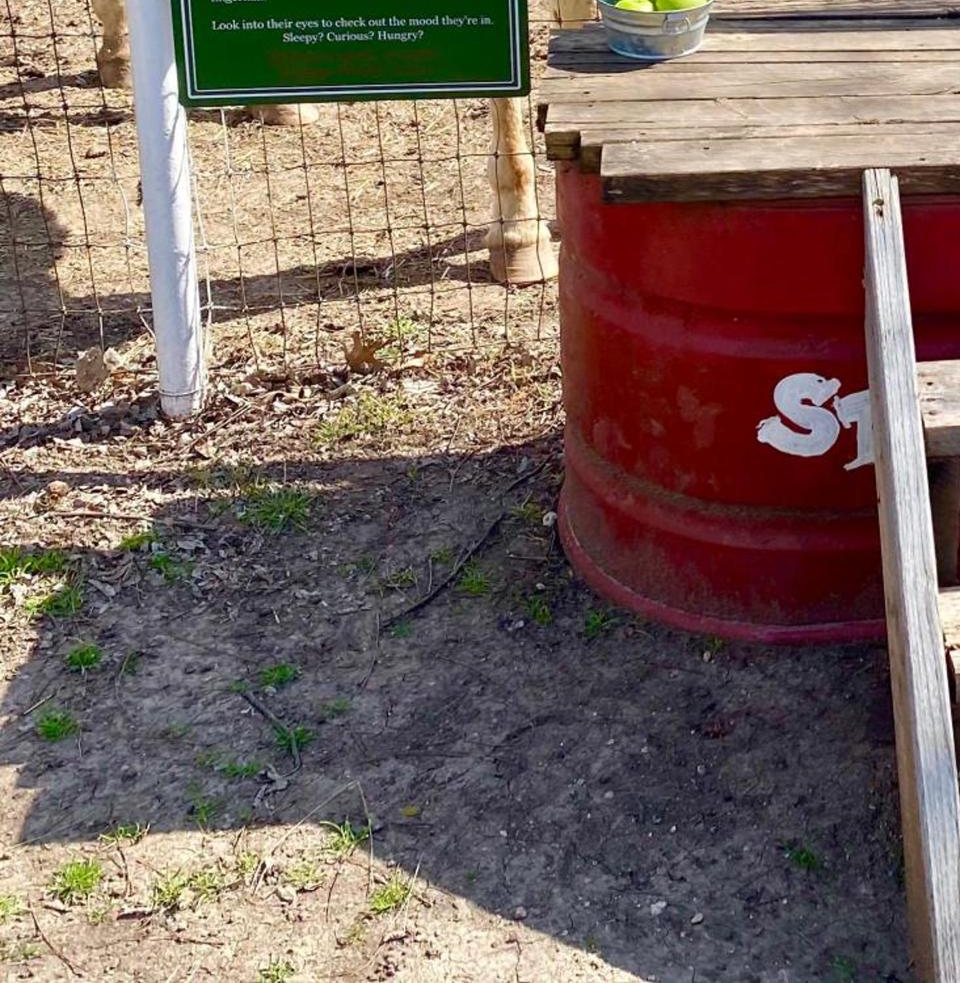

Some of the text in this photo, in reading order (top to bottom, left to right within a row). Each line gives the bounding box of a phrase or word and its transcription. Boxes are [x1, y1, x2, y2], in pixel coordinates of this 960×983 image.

[211, 20, 241, 31] Look
[241, 19, 265, 30] into
[266, 19, 293, 29] their
[295, 20, 319, 31] eyes
[321, 19, 333, 28] to
[335, 17, 366, 28] check
[368, 17, 385, 28] out
[387, 16, 406, 27] the
[408, 16, 439, 27] mood
[441, 15, 478, 28] they're
[282, 30, 424, 44] Sleepy? Curious? Hungry?
